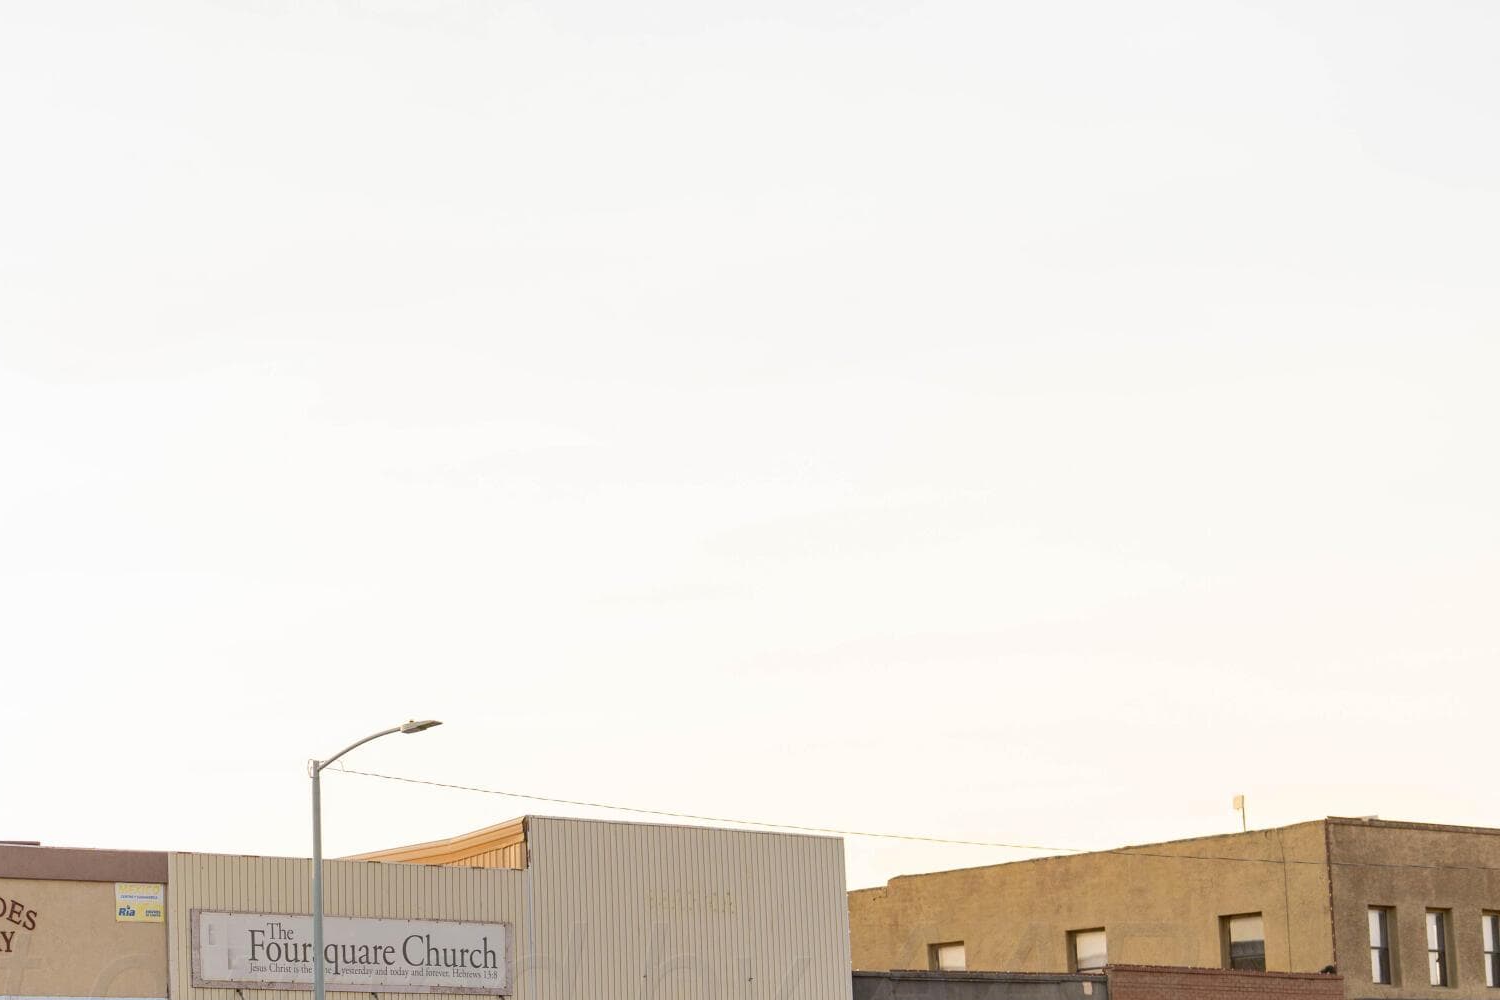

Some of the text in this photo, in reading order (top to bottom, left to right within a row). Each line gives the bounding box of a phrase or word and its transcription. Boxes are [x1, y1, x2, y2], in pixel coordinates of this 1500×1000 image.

[118, 905, 136, 917] Ria
[267, 922, 294, 941] The
[248, 929, 498, 975] Fourquare Church
[250, 963, 267, 974] Jesus
[269, 963, 292, 974] Christ
[301, 964, 312, 974] the
[375, 967, 388, 976] and
[390, 967, 409, 978] today
[411, 968, 423, 977] and
[452, 968, 482, 979] Hebrews
[483, 970, 498, 979] 13:8
